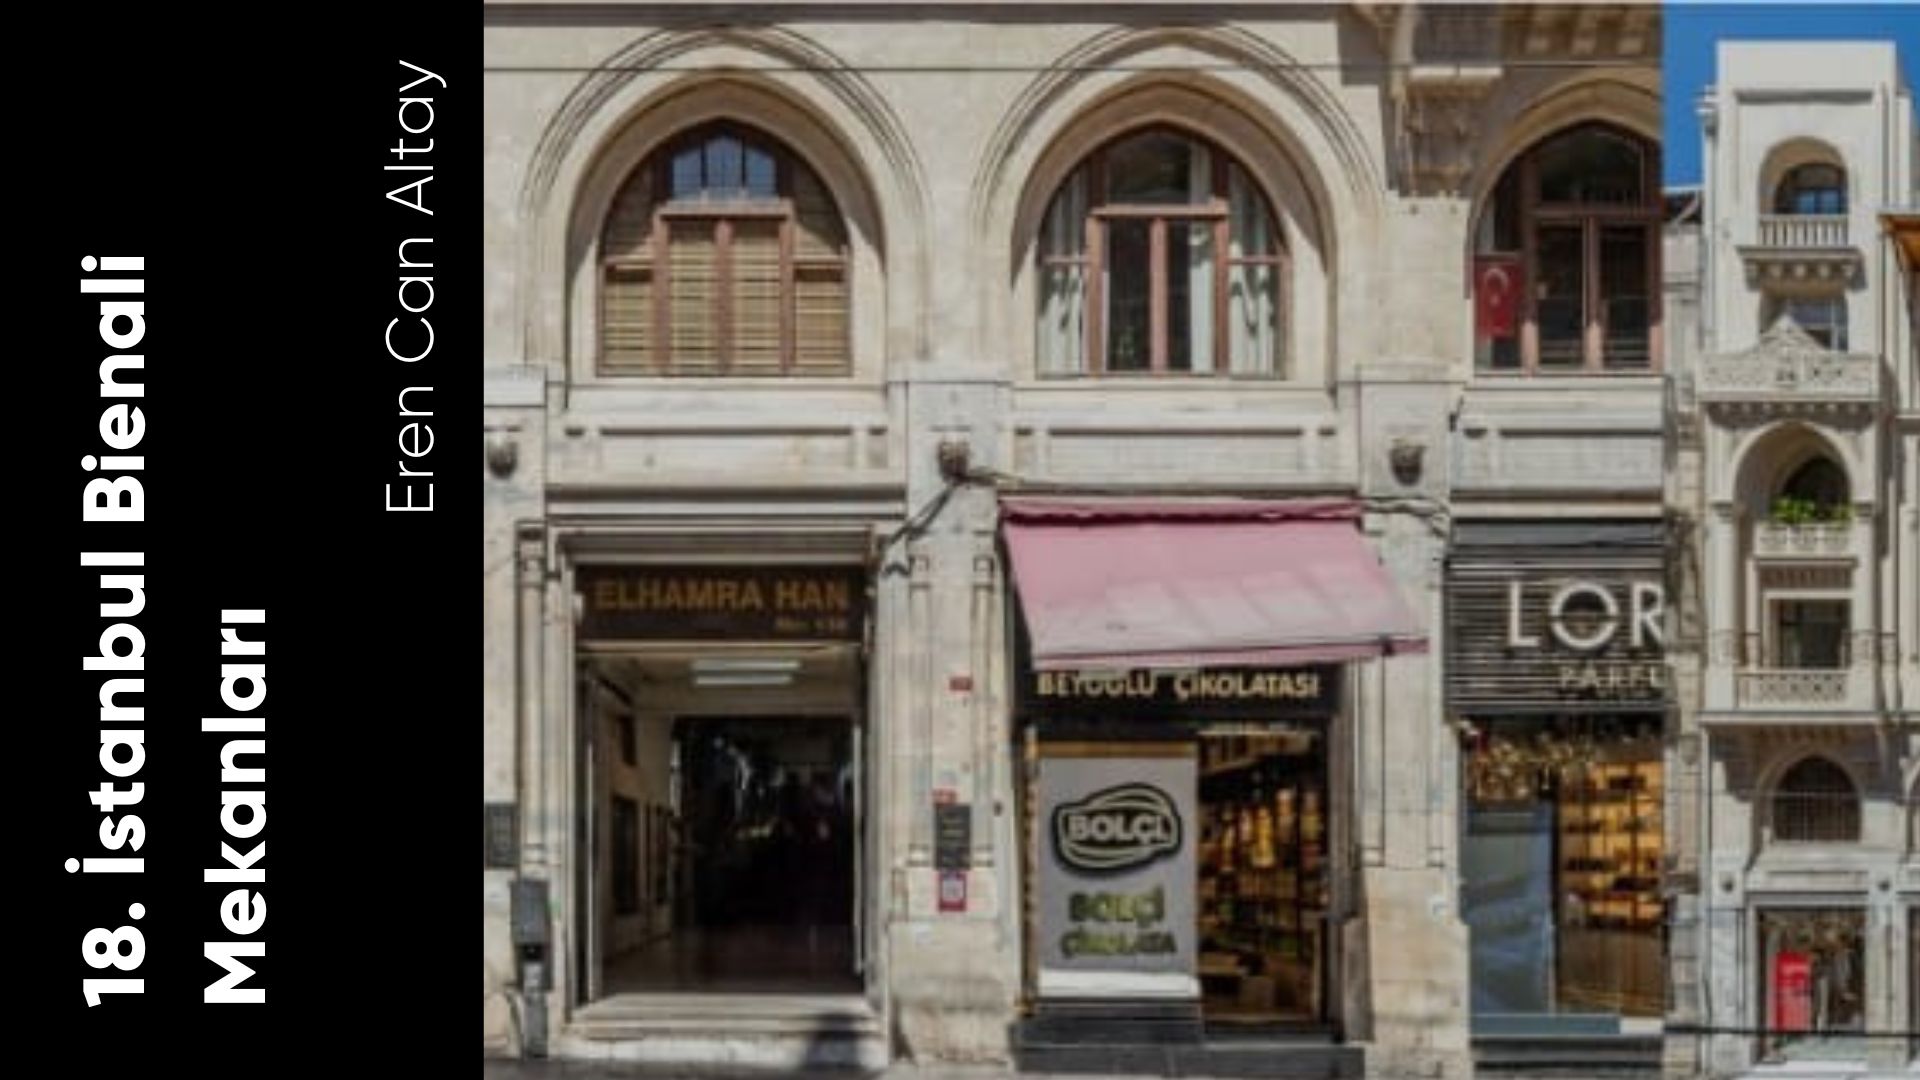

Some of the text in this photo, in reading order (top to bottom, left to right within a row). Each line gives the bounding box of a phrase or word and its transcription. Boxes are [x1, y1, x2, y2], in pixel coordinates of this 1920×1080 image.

[594, 578, 849, 611] ELHAMRA HAN
[1509, 580, 1663, 649] LOR
